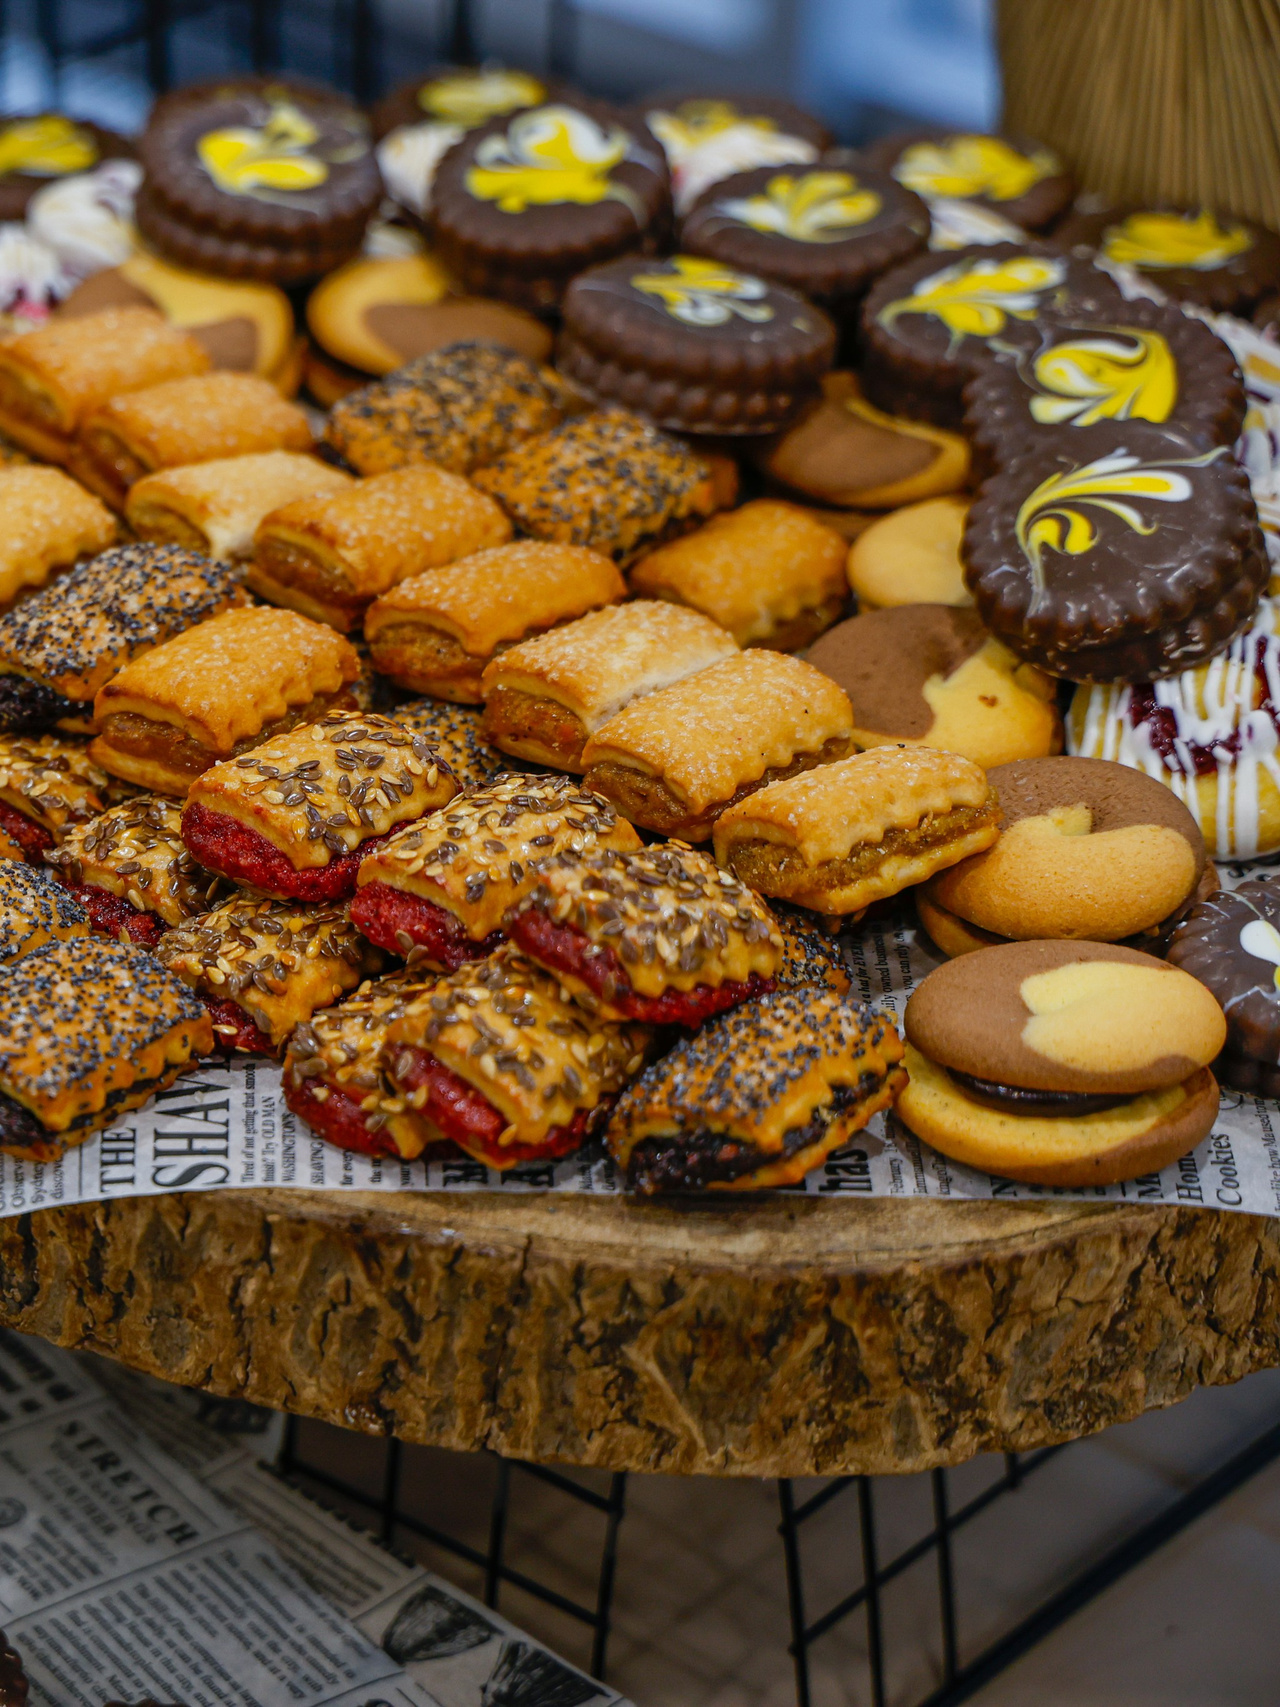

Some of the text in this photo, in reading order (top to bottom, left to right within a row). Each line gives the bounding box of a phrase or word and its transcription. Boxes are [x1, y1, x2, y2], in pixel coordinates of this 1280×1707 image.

[851, 941, 865, 966] EVER
[881, 995, 896, 1011] ily
[11, 1157, 26, 1209] Observa
[98, 1126, 137, 1193] THE
[819, 1149, 872, 1192] has
[889, 1157, 904, 1194] February
[1208, 1133, 1242, 1206] Cookies
[58, 1420, 200, 1555] STRETCH
